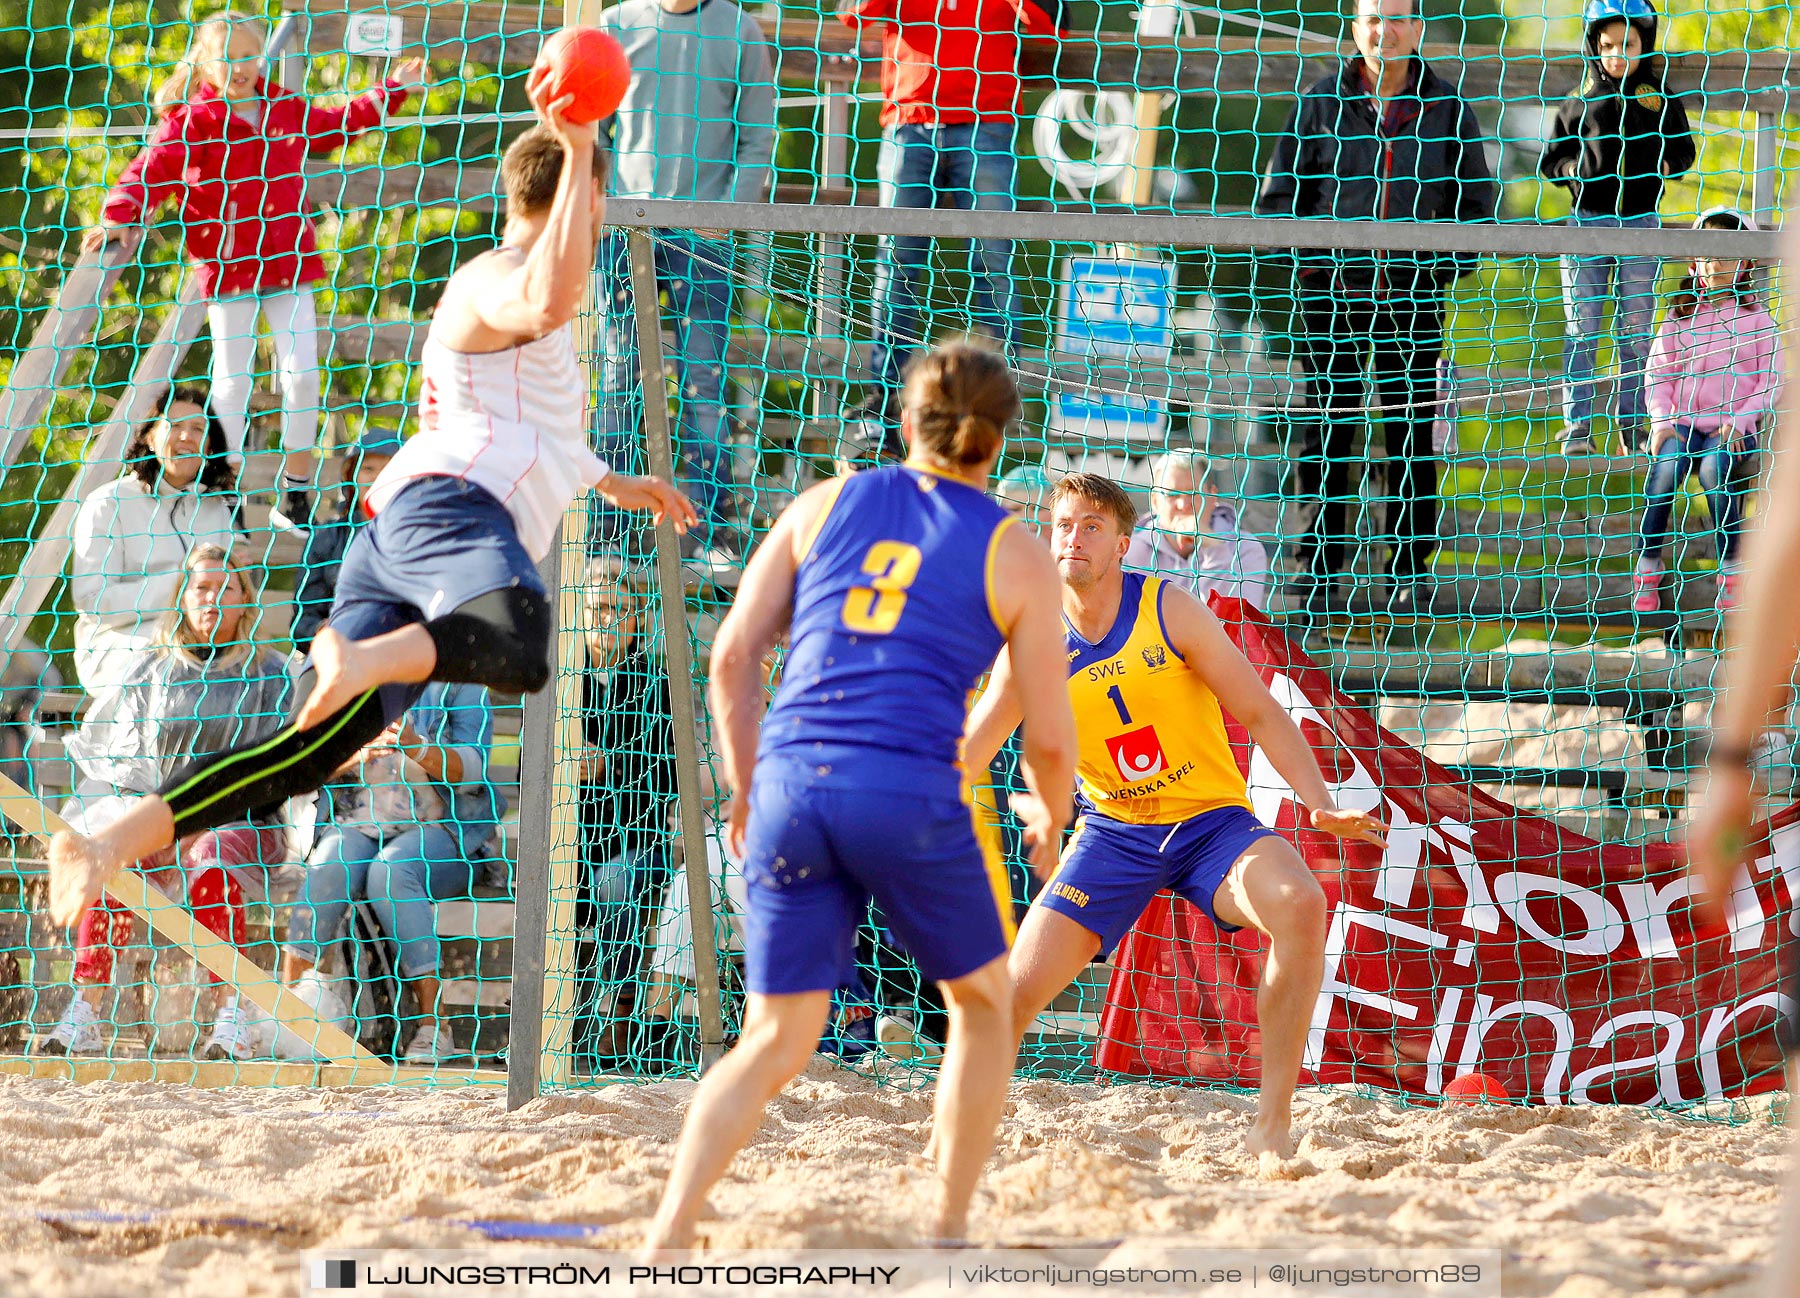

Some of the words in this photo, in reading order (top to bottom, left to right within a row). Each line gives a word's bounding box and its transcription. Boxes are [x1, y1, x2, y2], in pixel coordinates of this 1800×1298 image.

[841, 539, 923, 635] 3
[1088, 660, 1126, 682] SWE
[1106, 684, 1132, 725] 1
[1167, 761, 1196, 784] SPEL
[1051, 881, 1090, 908] ELMBERG
